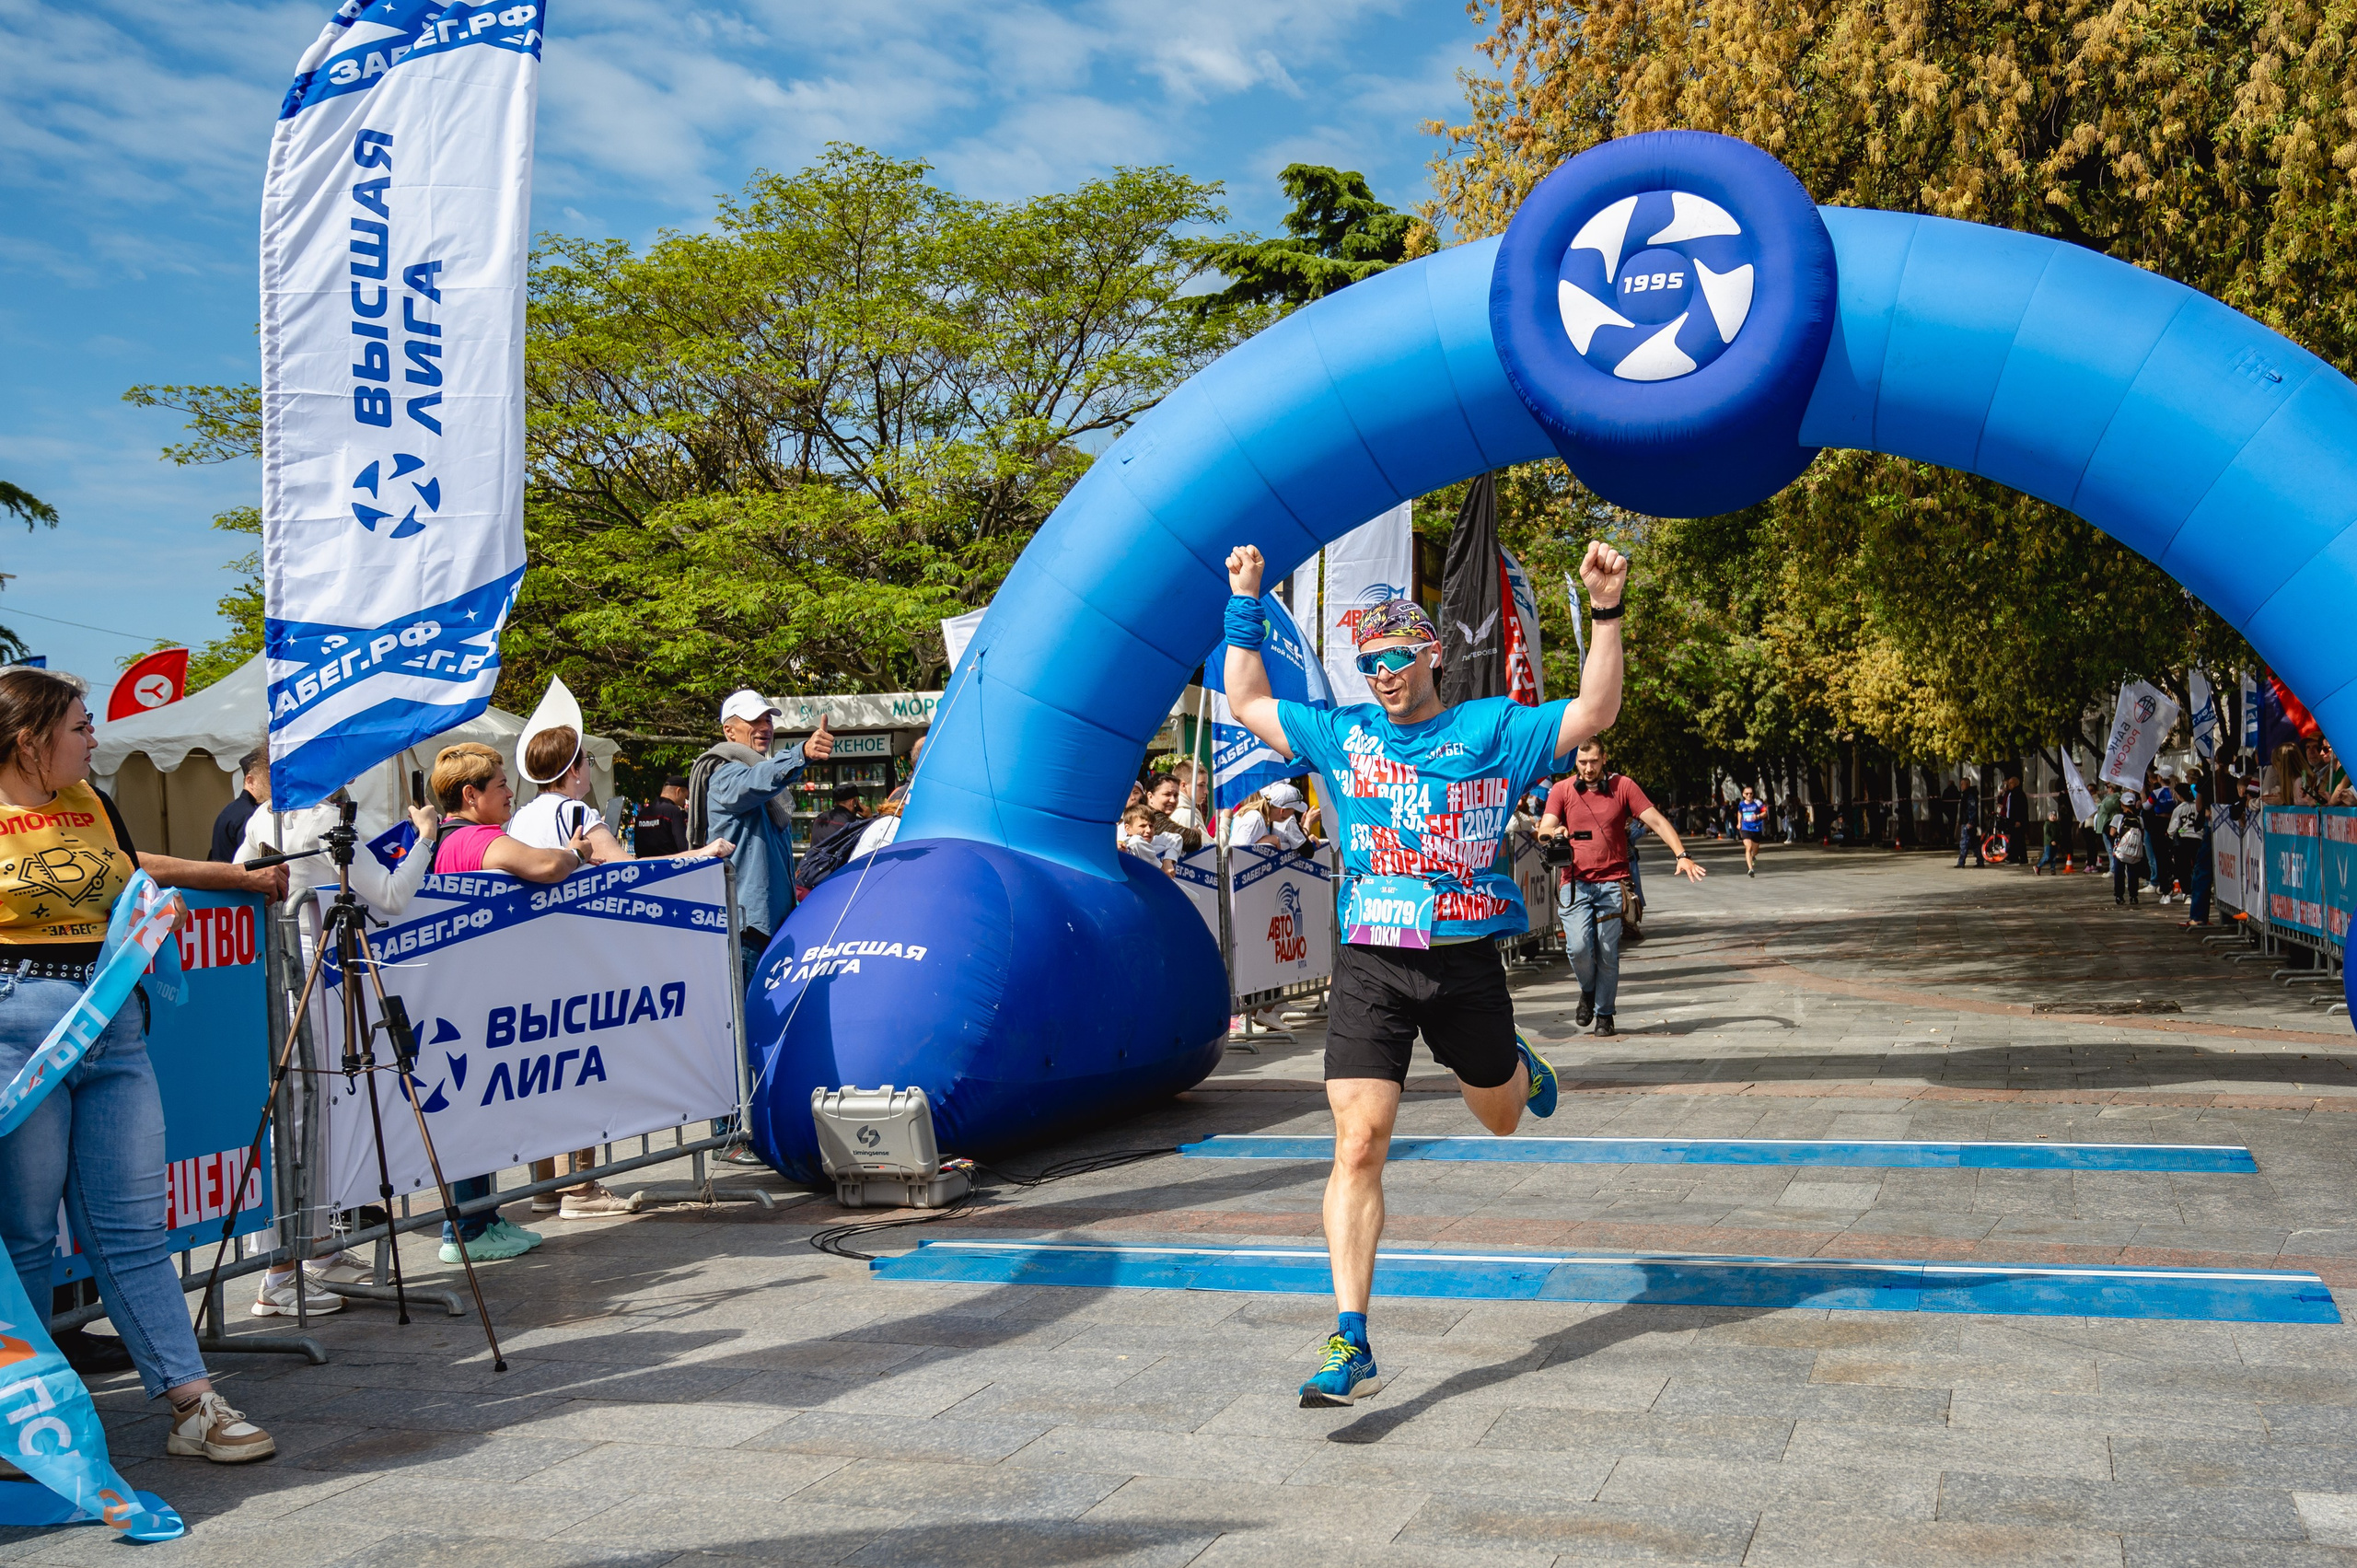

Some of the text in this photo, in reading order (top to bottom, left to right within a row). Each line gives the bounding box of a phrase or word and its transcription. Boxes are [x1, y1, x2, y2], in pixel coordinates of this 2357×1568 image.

[349, 128, 394, 429] ВЫСШАЯ
[1623, 272, 1684, 294] 1995
[402, 260, 443, 437] ЛИГА
[530, 865, 640, 911] ЗАБЕГ.РФ
[1241, 863, 1272, 884] ЗАБЕГ.РФ
[1363, 897, 1416, 926] 30079
[1267, 914, 1294, 942] АВТО
[800, 940, 928, 963] ВЫСШАЯ
[1275, 935, 1307, 964] РАДИО
[791, 958, 861, 982] ЛИГА
[484, 981, 687, 1050] ВЫСШАЯ
[480, 1045, 608, 1108] ЛИГА
